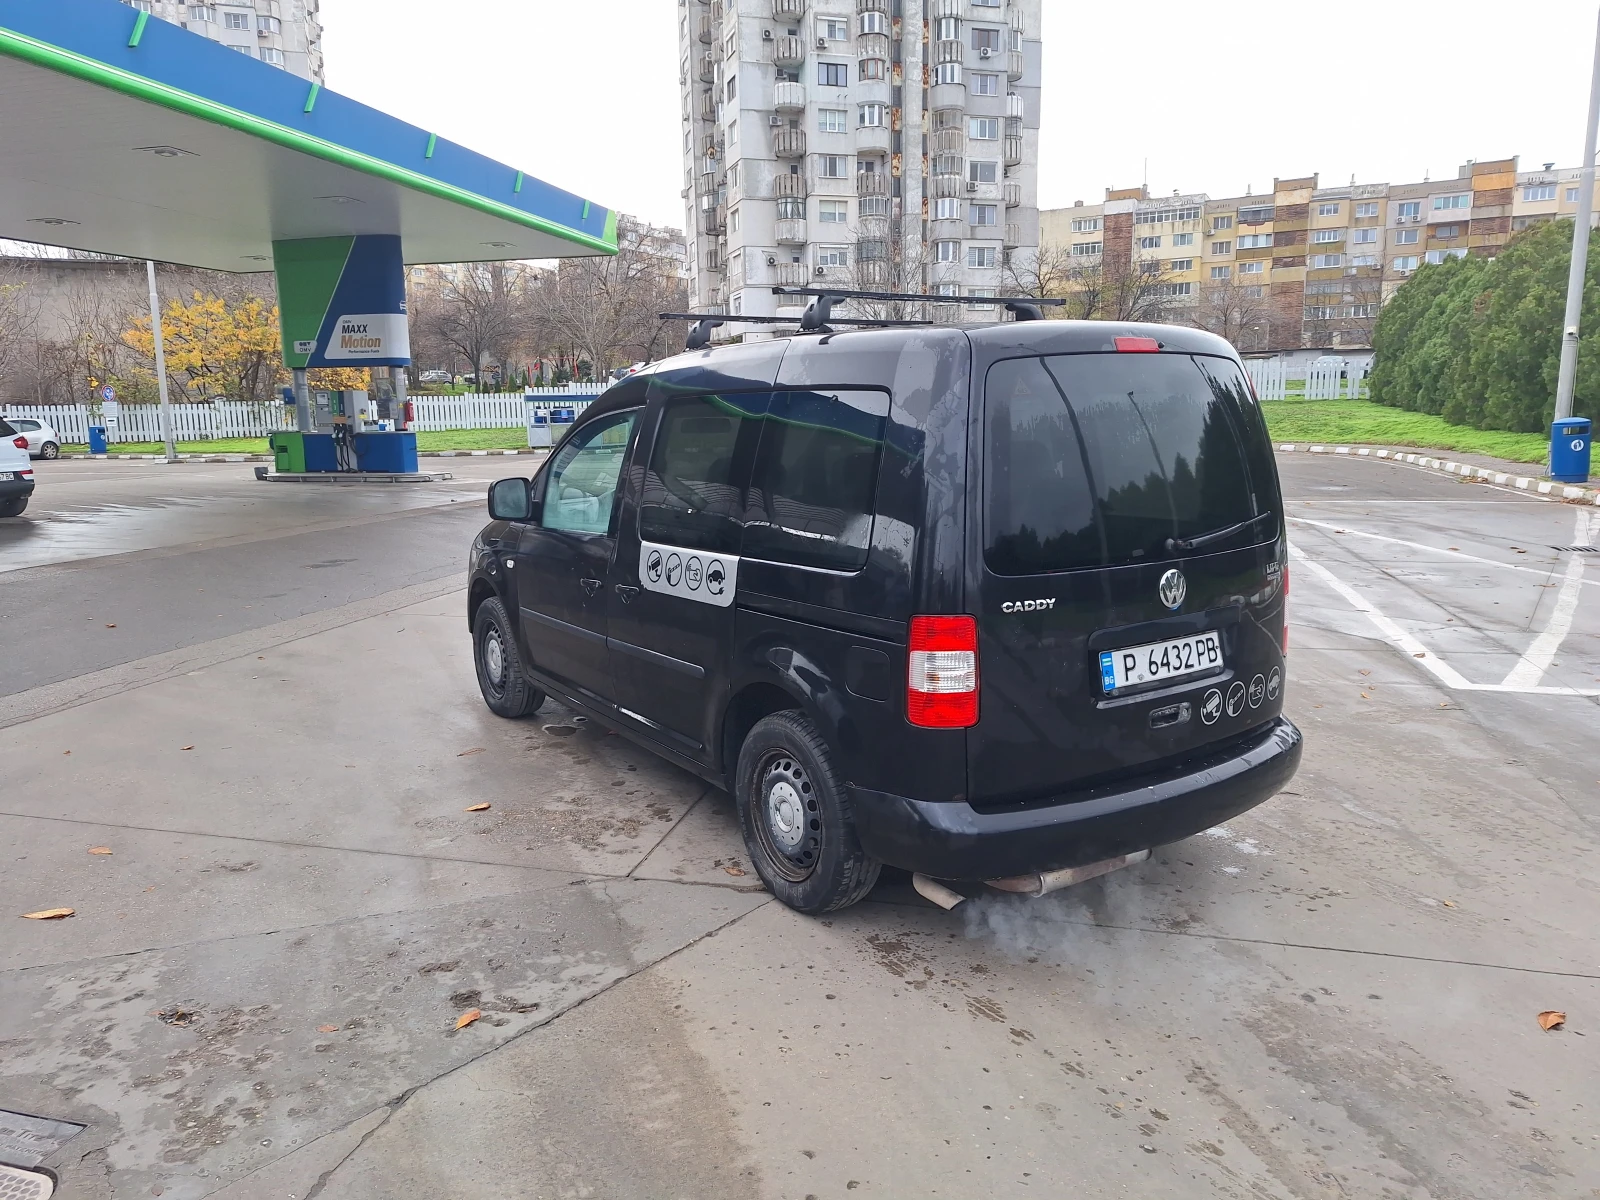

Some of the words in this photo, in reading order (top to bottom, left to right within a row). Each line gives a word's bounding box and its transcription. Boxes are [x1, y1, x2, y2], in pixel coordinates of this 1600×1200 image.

[341, 324, 368, 334] MAXX
[340, 335, 381, 349] Motion
[1001, 597, 1056, 614] CADDY
[1104, 675, 1115, 686] BG
